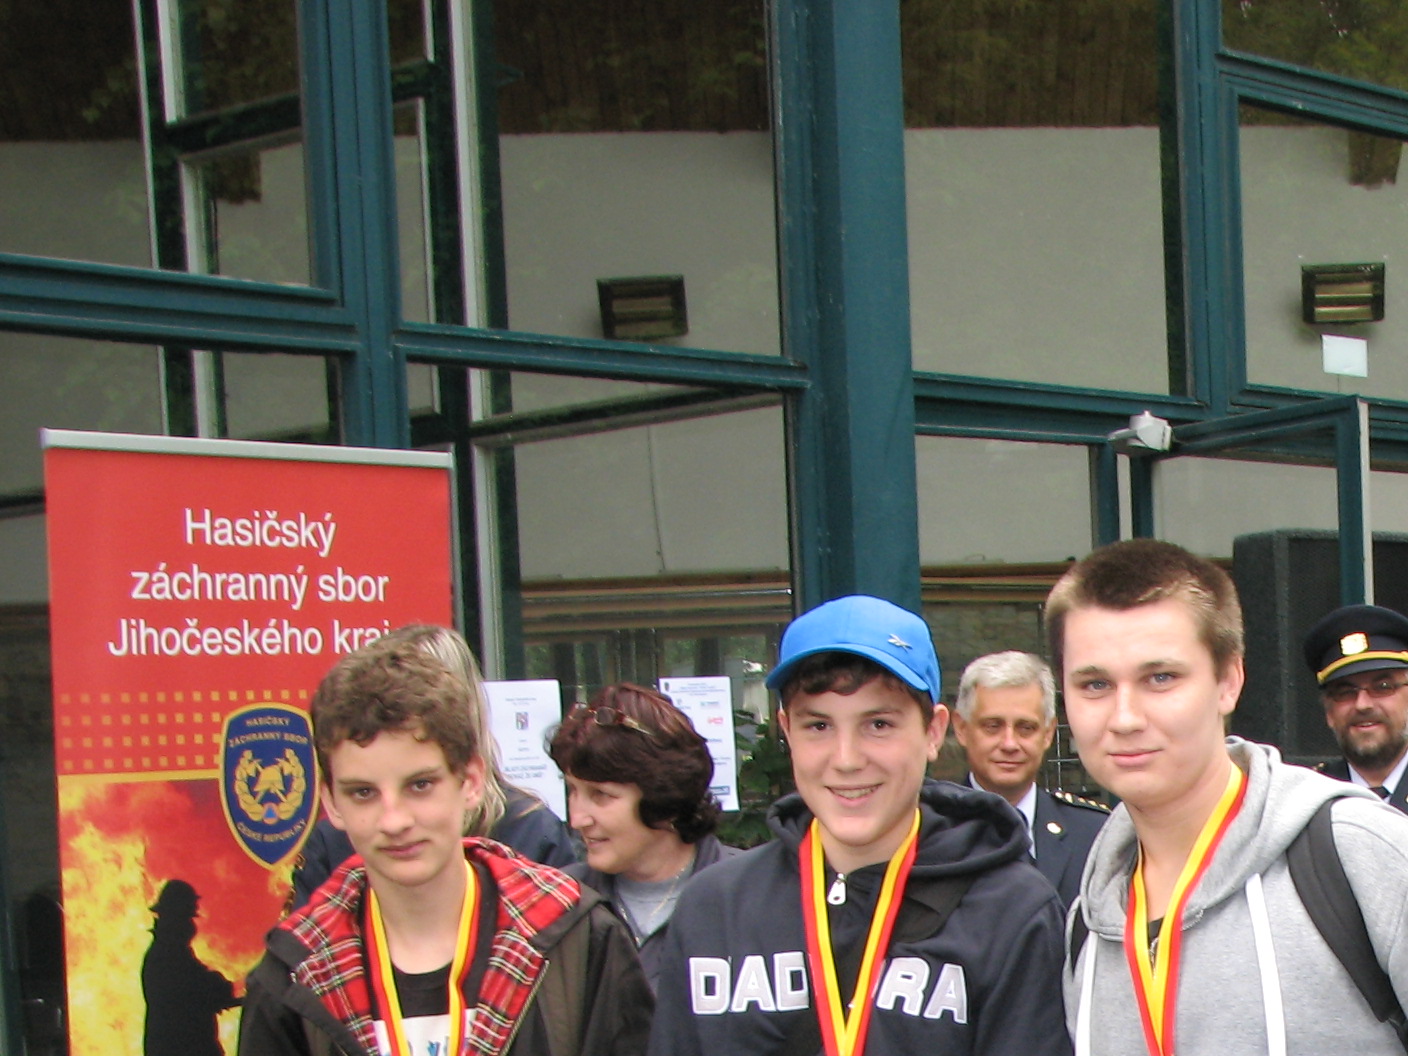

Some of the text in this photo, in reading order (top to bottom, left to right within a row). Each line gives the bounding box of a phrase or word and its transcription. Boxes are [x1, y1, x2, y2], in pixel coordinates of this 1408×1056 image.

[185, 507, 337, 557] Hasičský
[130, 562, 390, 611] záchranný sbor
[108, 618, 324, 656] Jihočeského
